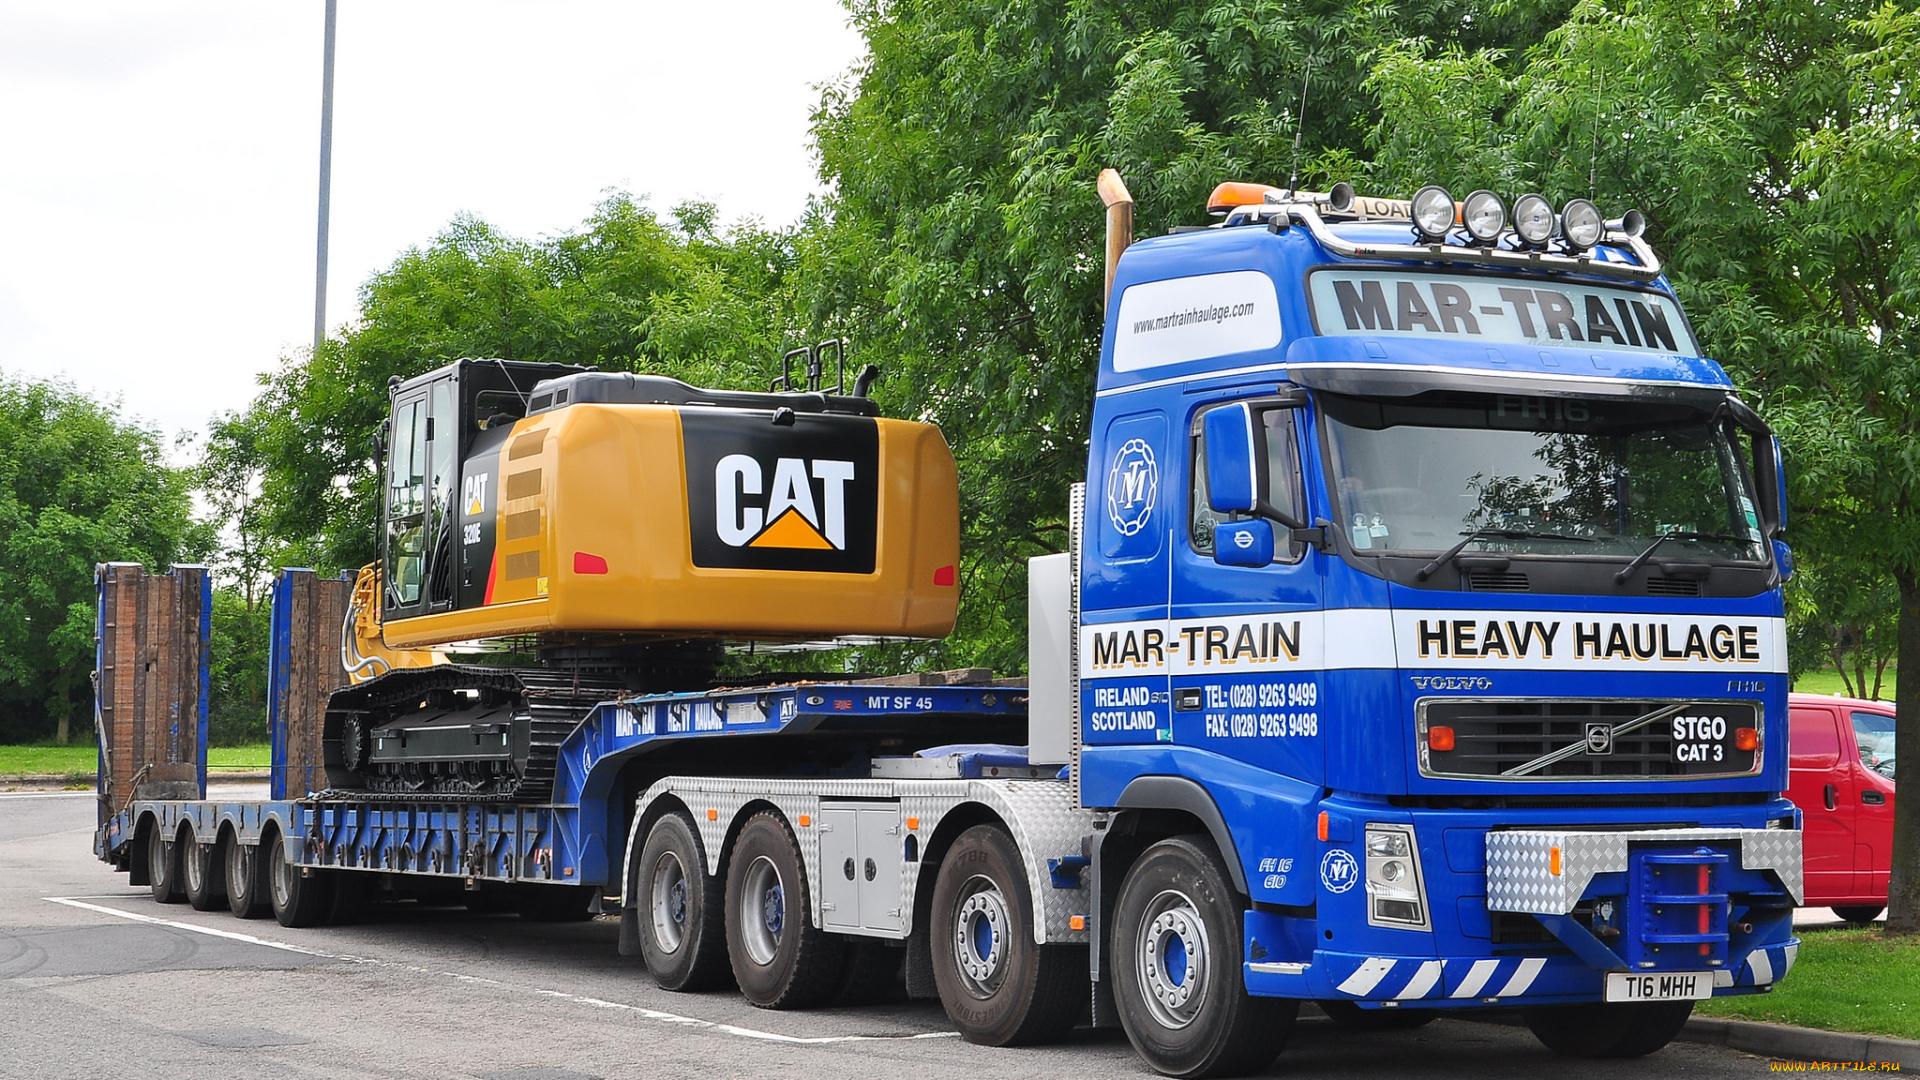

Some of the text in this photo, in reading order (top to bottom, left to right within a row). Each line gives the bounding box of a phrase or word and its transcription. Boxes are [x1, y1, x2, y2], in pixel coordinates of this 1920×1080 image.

[1133, 302, 1254, 334] www.martrainhaulage.com
[1332, 280, 1679, 352] MAR-TRAIN
[464, 473, 488, 516] CAT
[715, 453, 855, 550] CAT
[463, 522, 481, 545] 320E
[1092, 621, 1301, 669] MAR-TRAIN
[1417, 619, 1760, 662] HEAVY HAULAGE
[1205, 682, 1317, 708] TEL: (028) 9263 9499
[1410, 676, 1493, 690] VOLVO
[868, 696, 933, 710] MT SF 45
[1095, 686, 1150, 707] IRELAND
[1091, 710, 1156, 731] SCOTLAND
[1205, 712, 1318, 738] FAX: (028) 9263 9498
[1673, 716, 1727, 741] STGO
[1676, 744, 1723, 762] CAT 3
[1263, 874, 1287, 889] 610
[1626, 975, 1697, 998] T16 MHH
